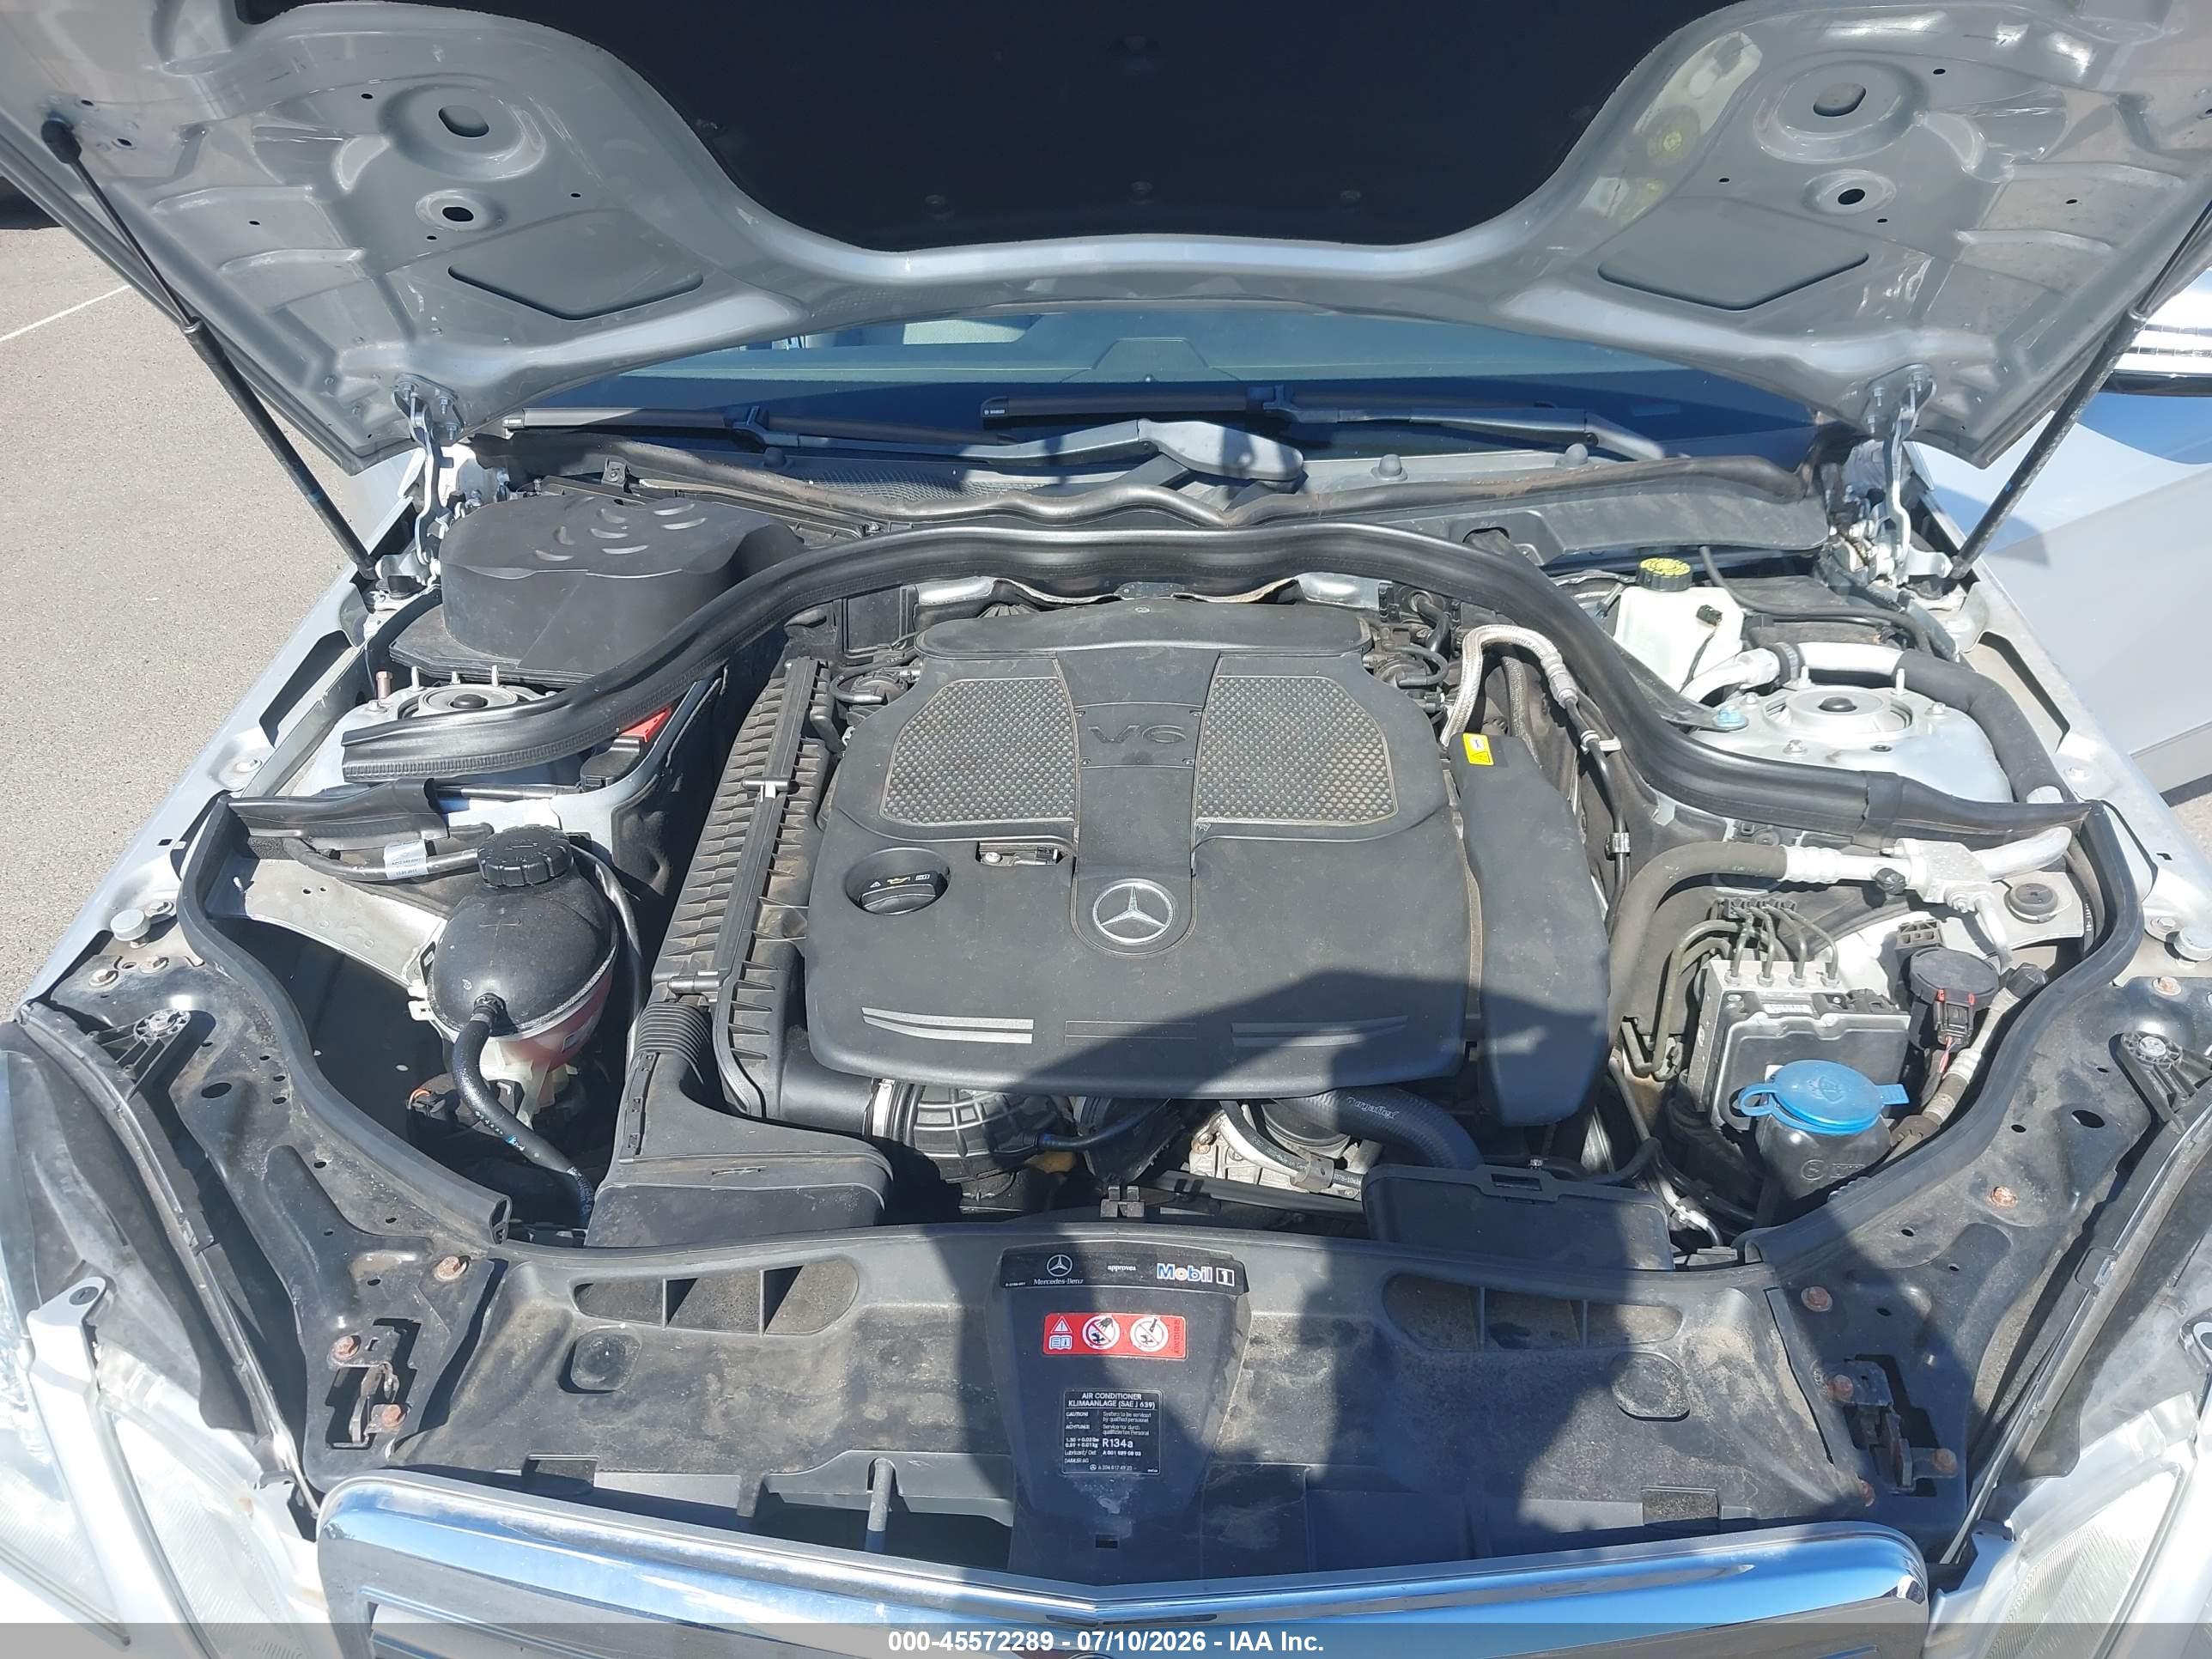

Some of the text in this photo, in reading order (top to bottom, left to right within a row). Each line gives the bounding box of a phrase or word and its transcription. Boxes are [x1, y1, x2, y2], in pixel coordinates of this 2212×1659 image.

[1087, 723, 1187, 744] V6
[1157, 1262, 1213, 1283] Mobil
[1139, 1401, 1155, 1410] 639)
[1102, 1437, 1133, 1449] R134a
